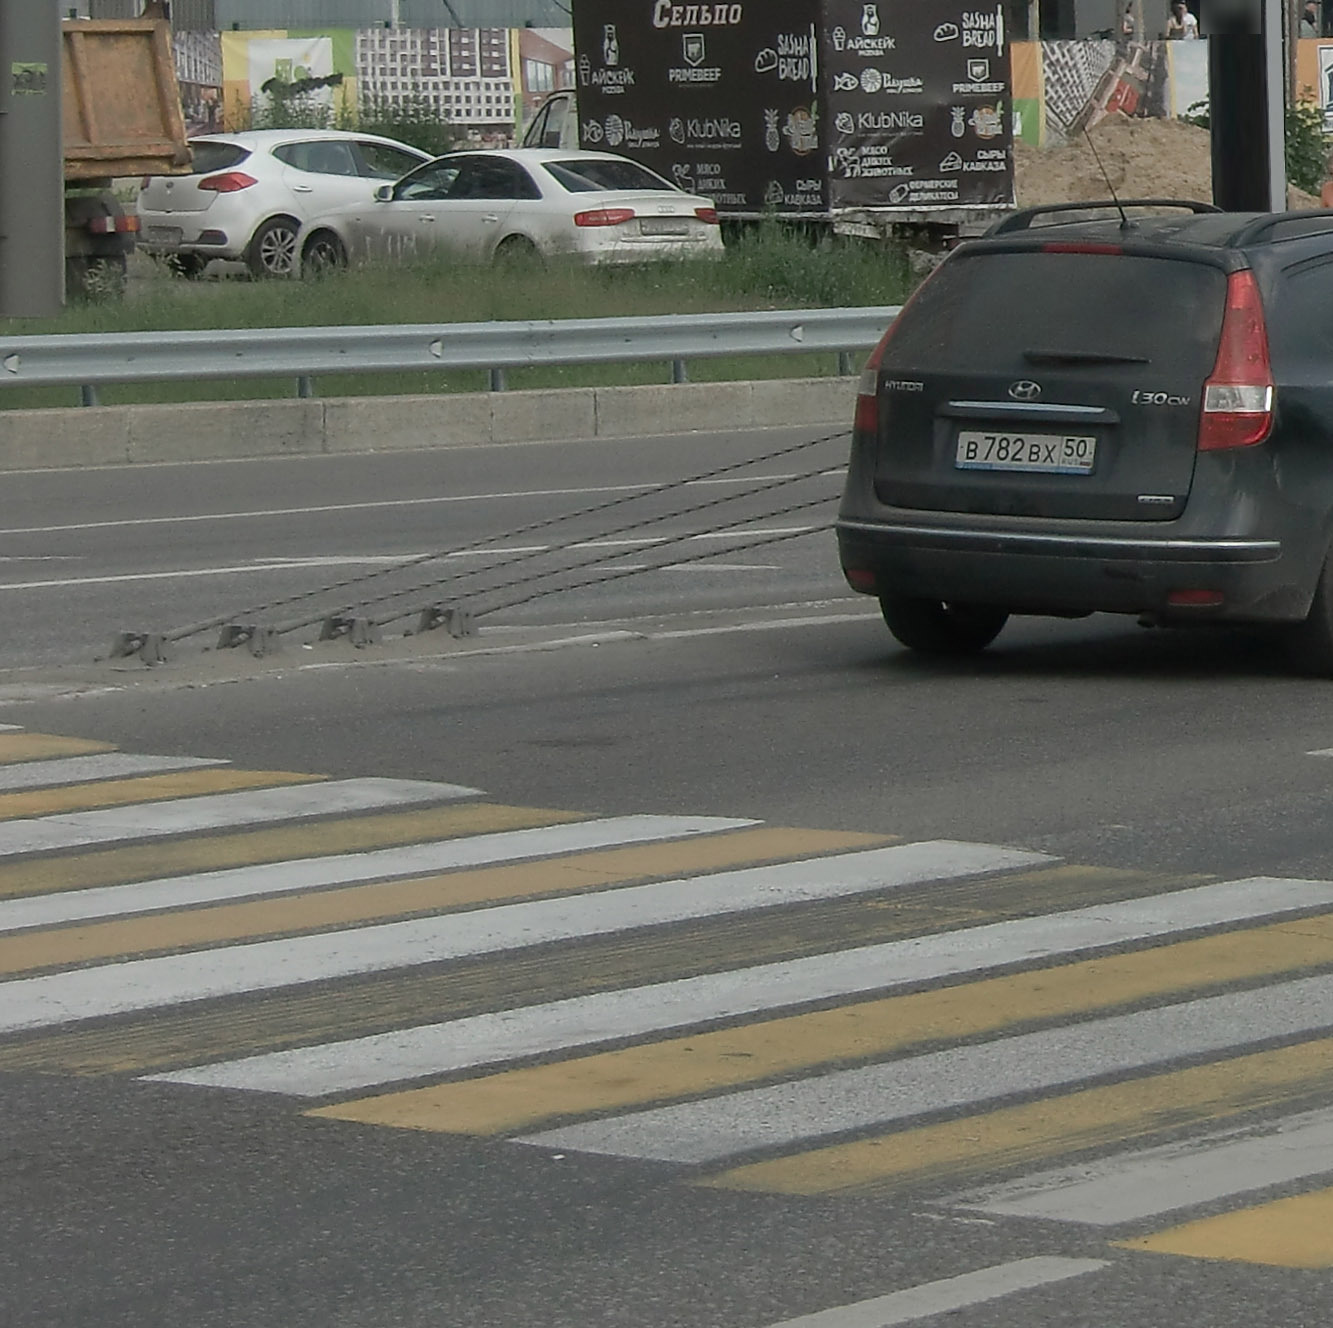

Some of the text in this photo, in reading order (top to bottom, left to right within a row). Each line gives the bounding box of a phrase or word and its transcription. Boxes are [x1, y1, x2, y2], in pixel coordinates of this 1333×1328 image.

[962, 12, 996, 30] SASHA
[777, 33, 809, 56] SASHA
[846, 36, 896, 50] АЙСКЕЙК
[962, 30, 996, 48] BREAD
[591, 67, 635, 85] АЙСКЕЙК
[668, 67, 722, 82] PRIMEBEEF
[778, 58, 809, 81] BREAD
[952, 82, 1006, 93] PRIMEBEEF
[858, 111, 924, 129] KlubNika
[687, 118, 742, 139] KlubNika
[861, 146, 888, 156] МЯСО
[976, 150, 1006, 160] СЫРЫ
[962, 161, 1007, 172] КАВКАЗА
[796, 179, 822, 191] СЫРЫ
[784, 194, 823, 205] КАВКАЗА
[885, 380, 925, 393] HYUNDAI
[1062, 438, 1088, 459] 50
